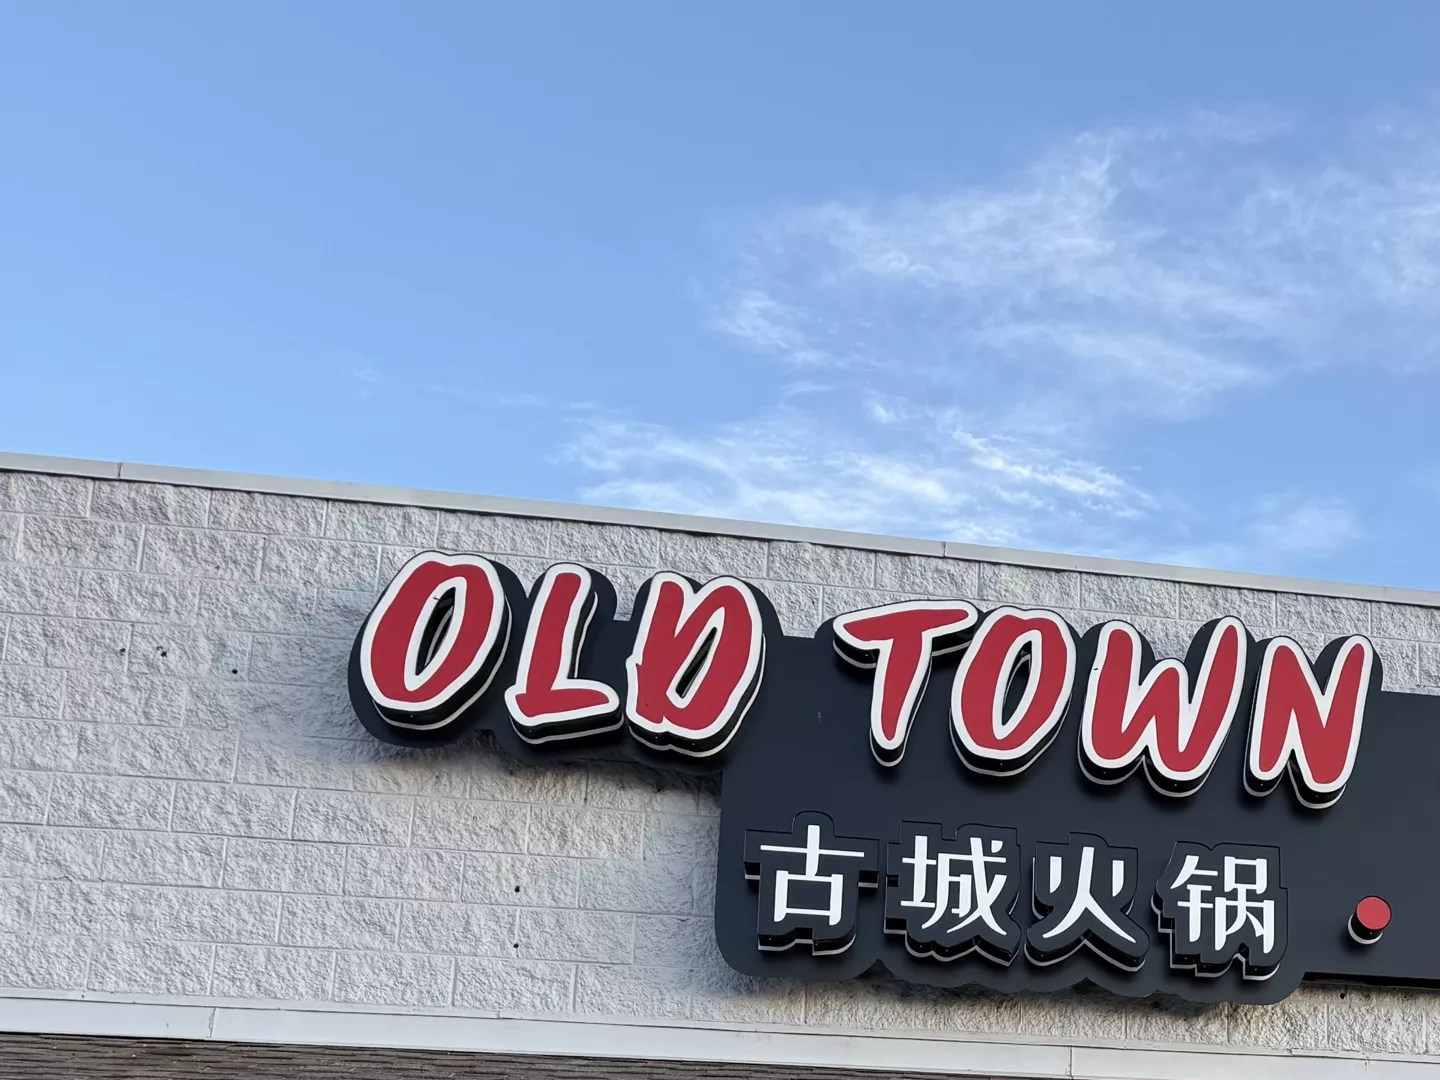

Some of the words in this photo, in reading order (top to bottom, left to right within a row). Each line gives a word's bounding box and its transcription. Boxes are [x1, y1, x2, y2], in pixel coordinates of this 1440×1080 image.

[357, 551, 762, 755] OLD
[831, 600, 1376, 799] TOWN
[759, 822, 1275, 956] 古城火锅
